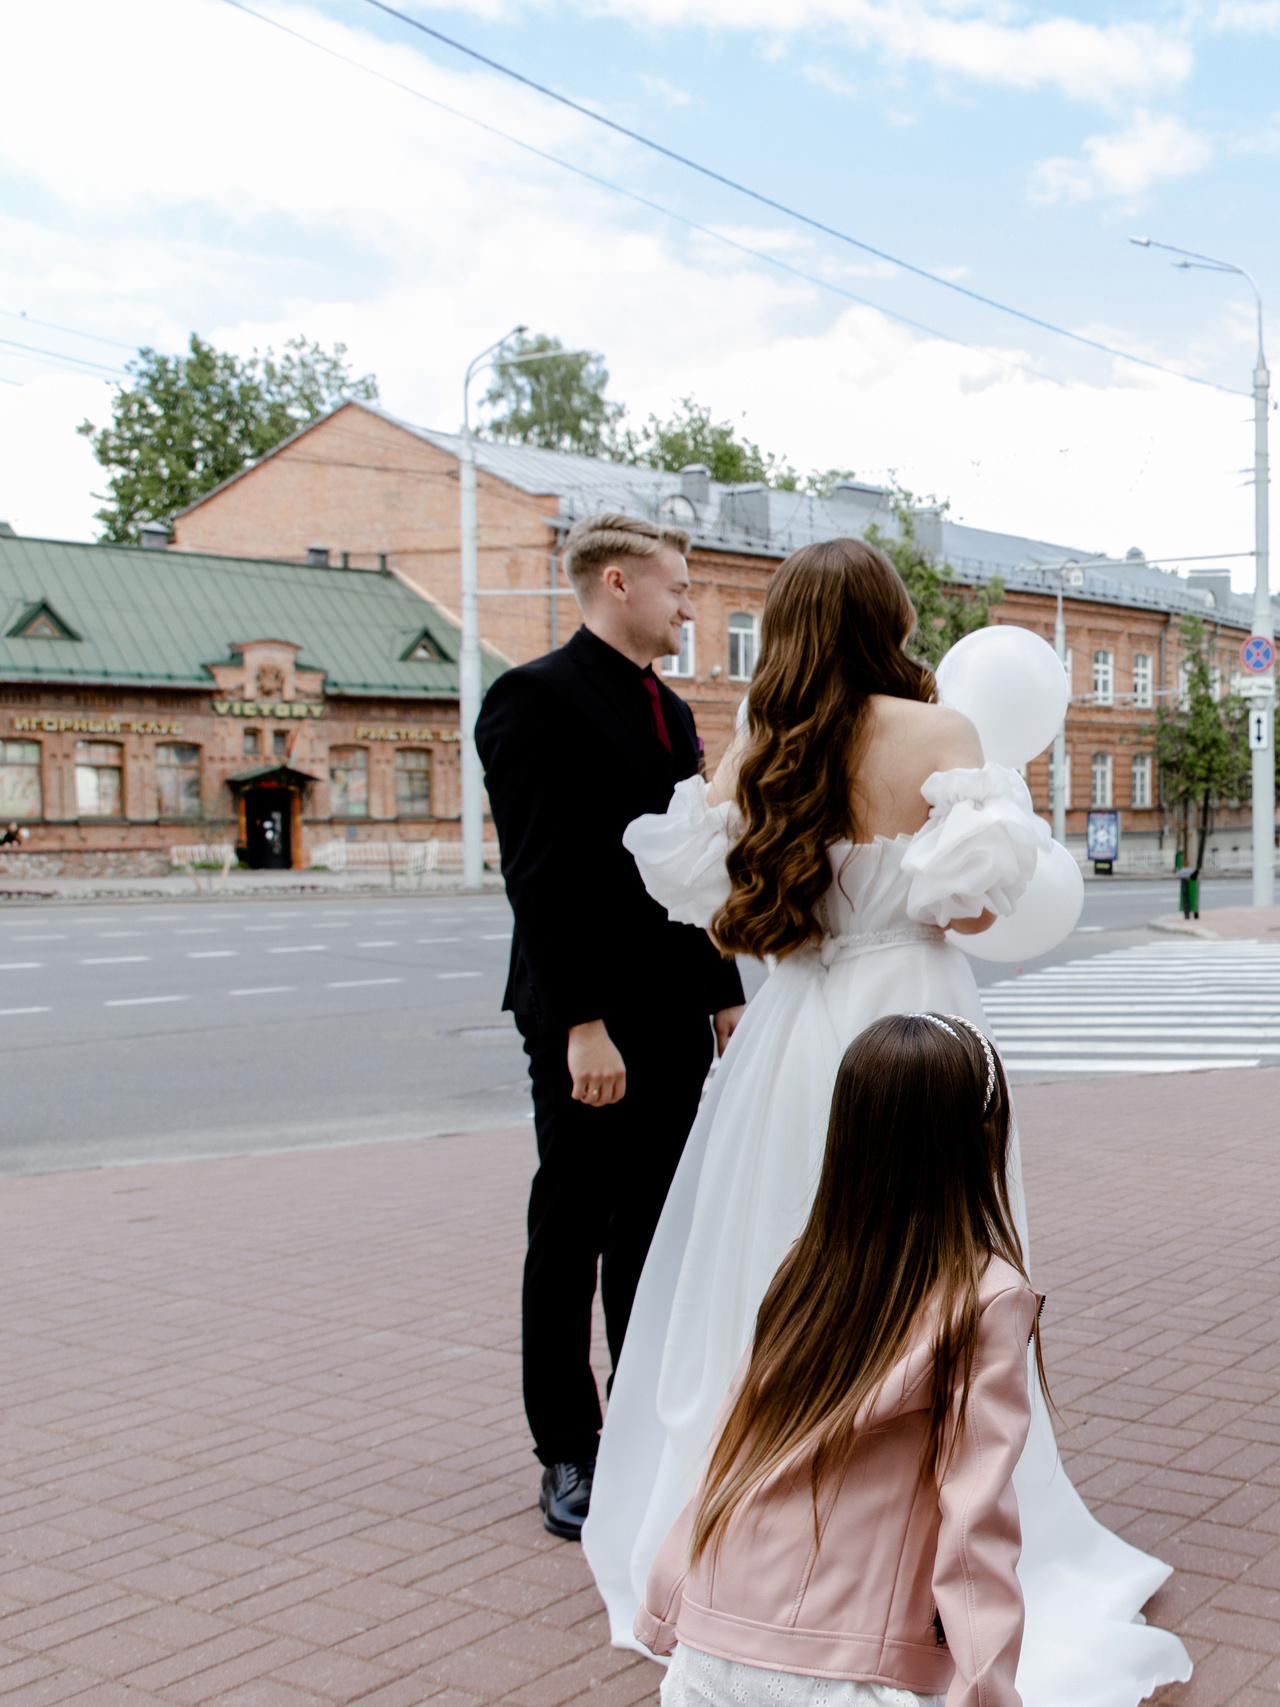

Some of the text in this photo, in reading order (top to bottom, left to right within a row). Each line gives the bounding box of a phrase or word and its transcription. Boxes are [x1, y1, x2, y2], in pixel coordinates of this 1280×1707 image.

[213, 701, 325, 718] VICTORY
[12, 716, 185, 735] ИГОРНЫЙ КЛУБ
